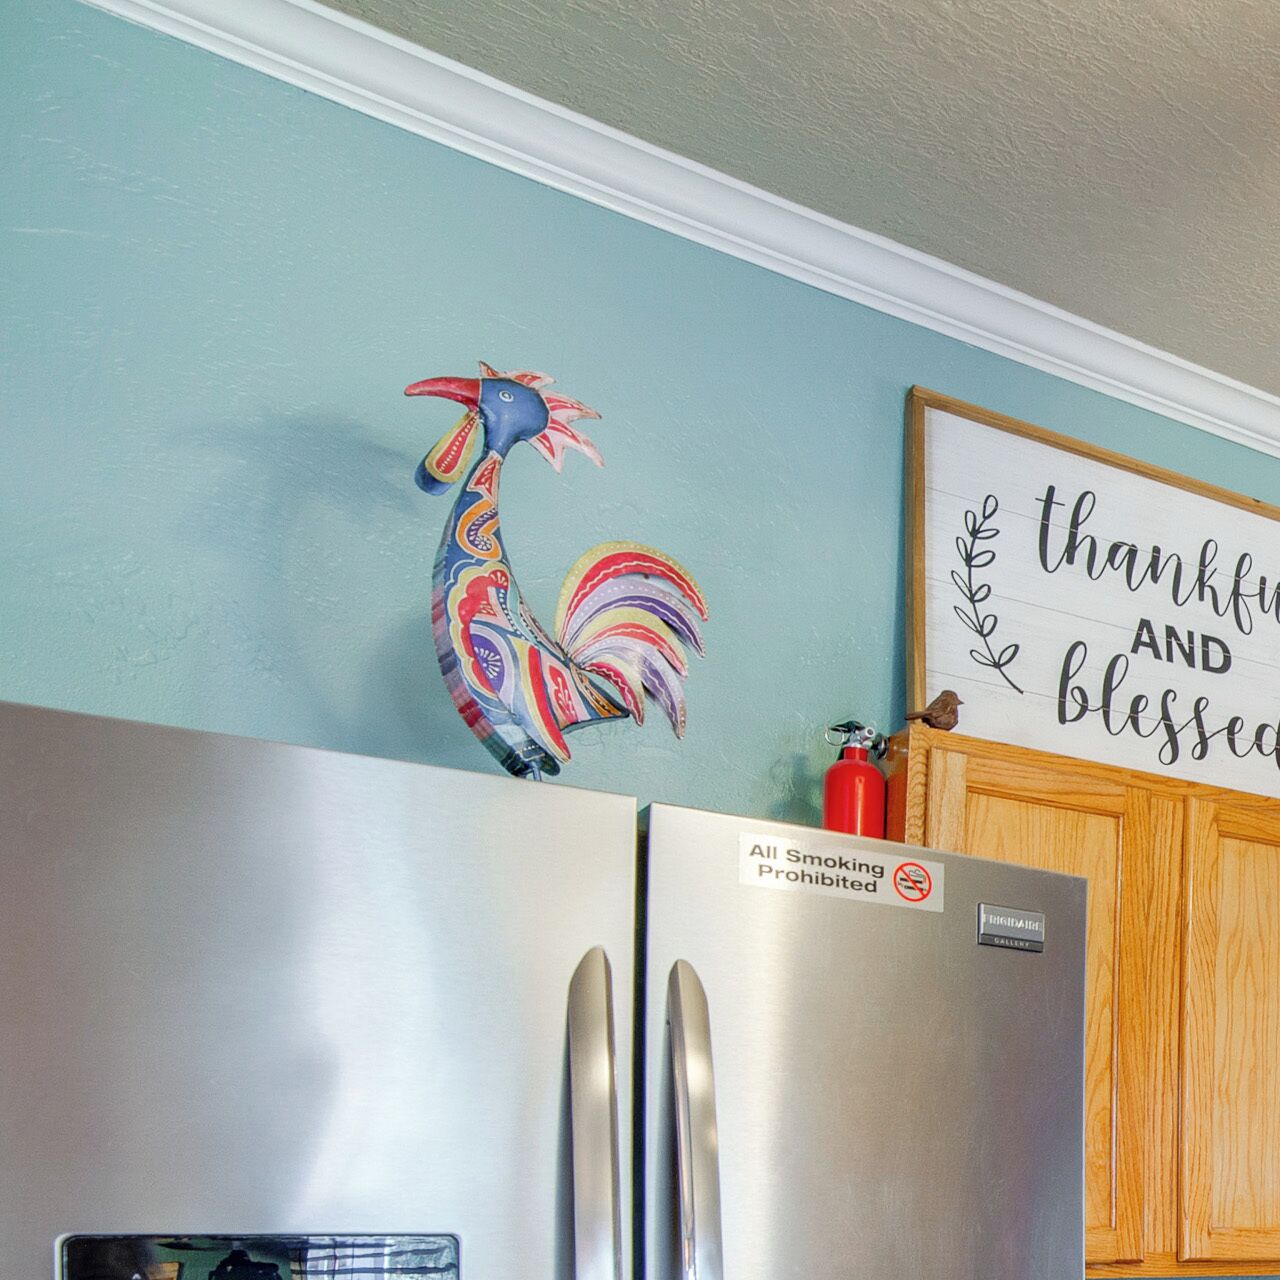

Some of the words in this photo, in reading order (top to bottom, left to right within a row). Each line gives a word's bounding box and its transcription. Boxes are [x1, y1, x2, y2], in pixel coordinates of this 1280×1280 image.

[1131, 617, 1232, 674] AND
[749, 844, 777, 860] All
[786, 848, 885, 879] Smoking
[758, 864, 878, 893] Prohibited
[983, 913, 1043, 931] FRIGIDAIRE
[994, 937, 1030, 947] GALLERY
